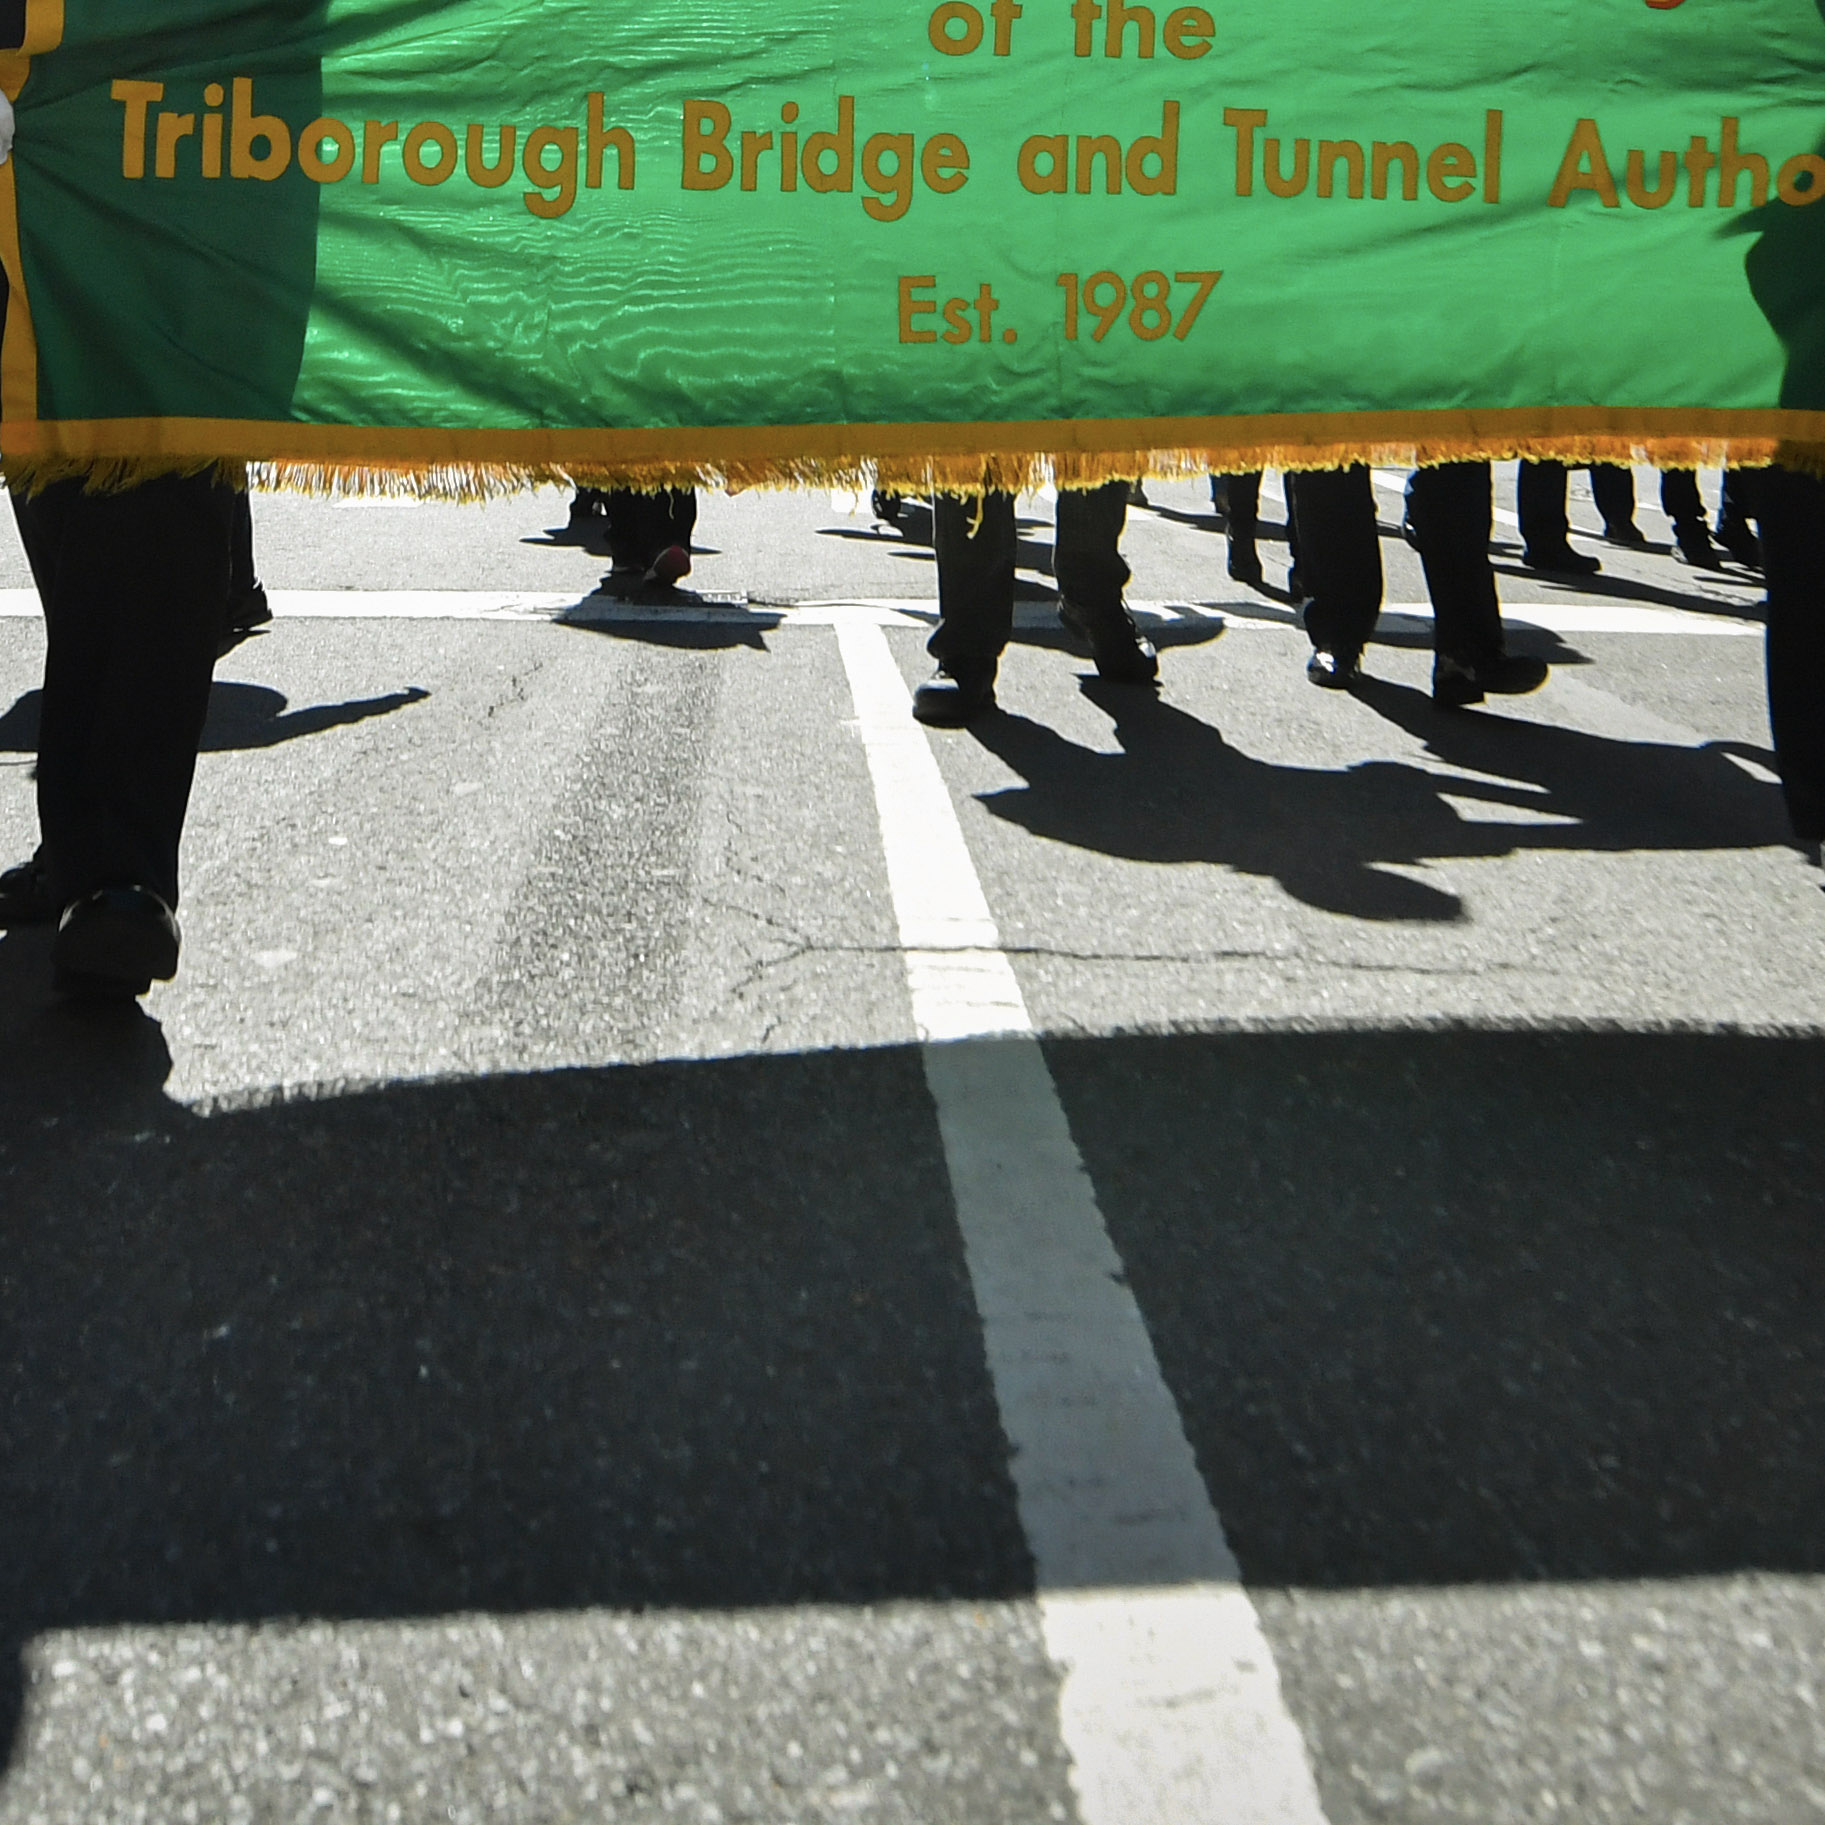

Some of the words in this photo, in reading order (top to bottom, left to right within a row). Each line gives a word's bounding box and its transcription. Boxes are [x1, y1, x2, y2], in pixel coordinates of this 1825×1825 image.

[110, 75, 635, 218] Triborough
[682, 95, 969, 221] Bridge
[1018, 100, 1179, 195] and
[1224, 108, 1502, 203] Tunnel
[899, 275, 1018, 345] Est.
[1057, 270, 1222, 343] 1987
